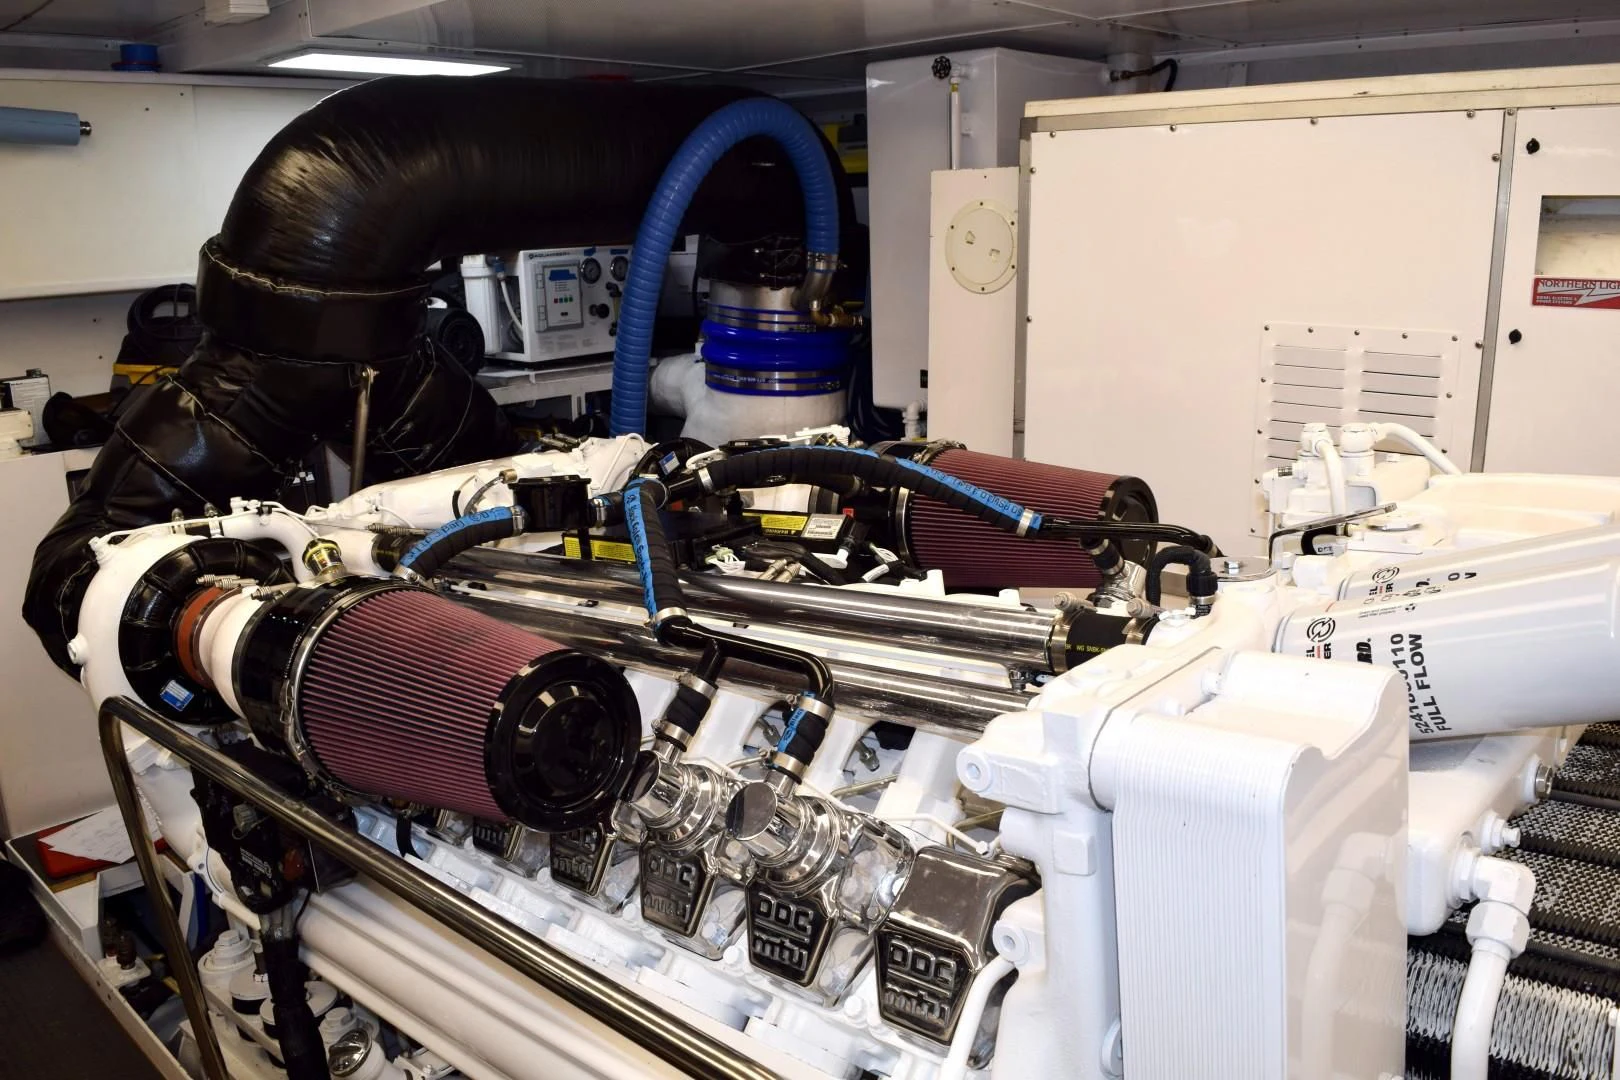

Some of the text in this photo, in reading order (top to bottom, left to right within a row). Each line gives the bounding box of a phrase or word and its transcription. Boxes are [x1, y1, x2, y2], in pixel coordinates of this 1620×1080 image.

[1539, 279, 1596, 290] NORTHERN
[1408, 633, 1452, 731] FULL FLOW
[755, 891, 814, 937] DDC
[751, 929, 808, 971] mtu
[887, 939, 957, 988] DDC
